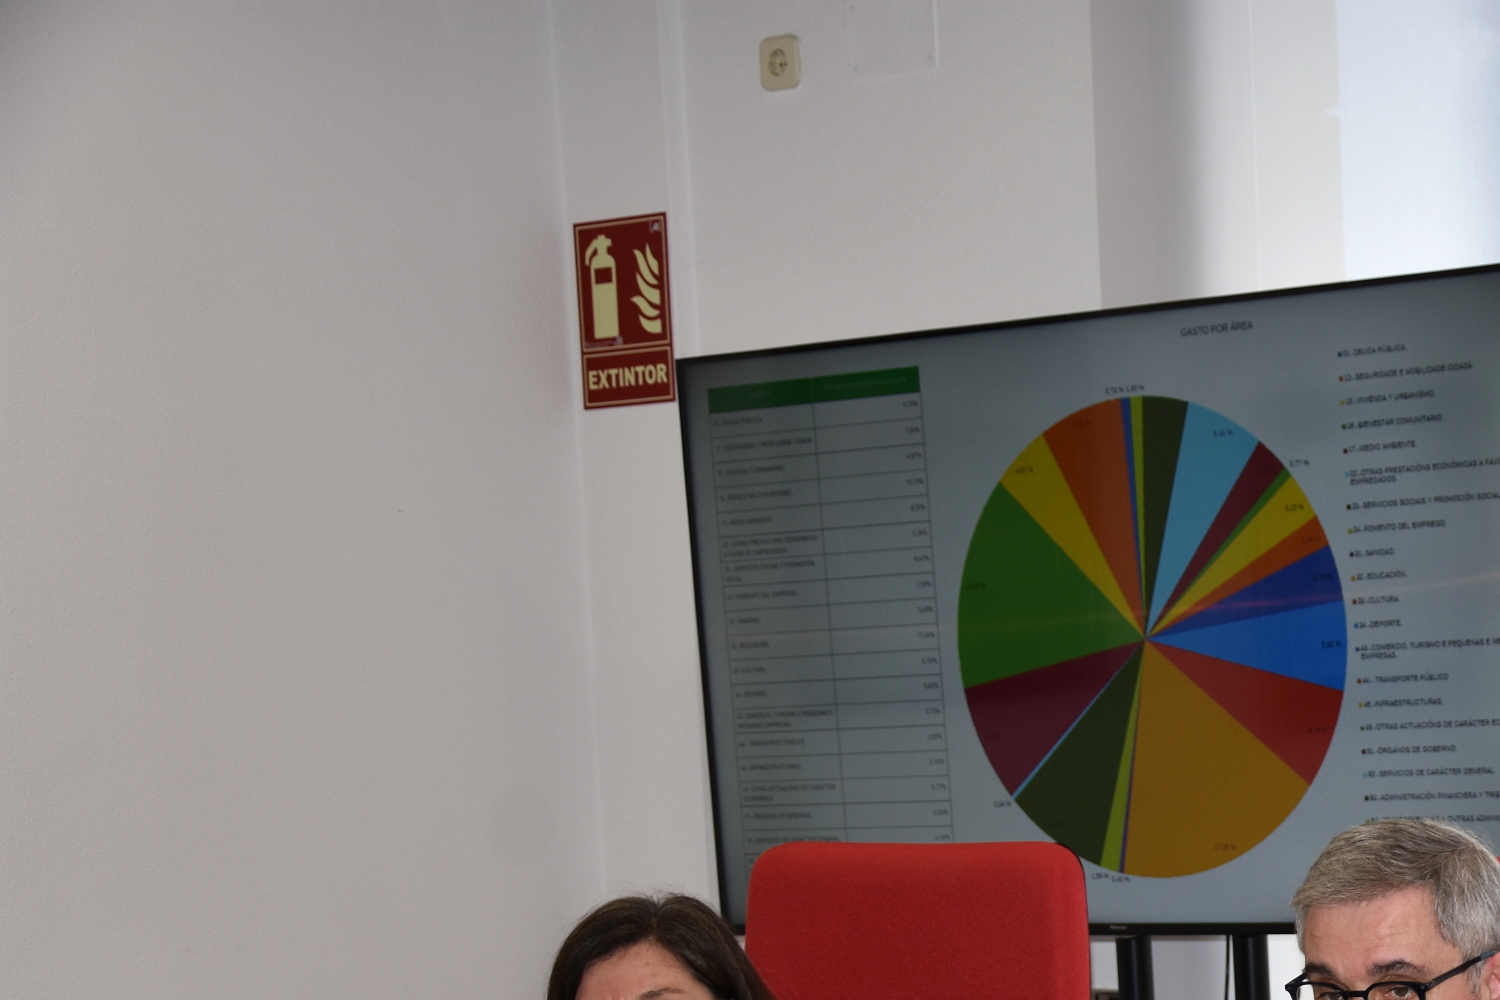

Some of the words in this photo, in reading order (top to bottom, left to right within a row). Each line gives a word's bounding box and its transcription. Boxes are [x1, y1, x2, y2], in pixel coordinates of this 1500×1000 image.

[1180, 323, 1209, 337] GASTO
[1210, 322, 1229, 334] POR
[1230, 319, 1254, 332] ÁREA
[588, 363, 668, 391] EXTINTOR
